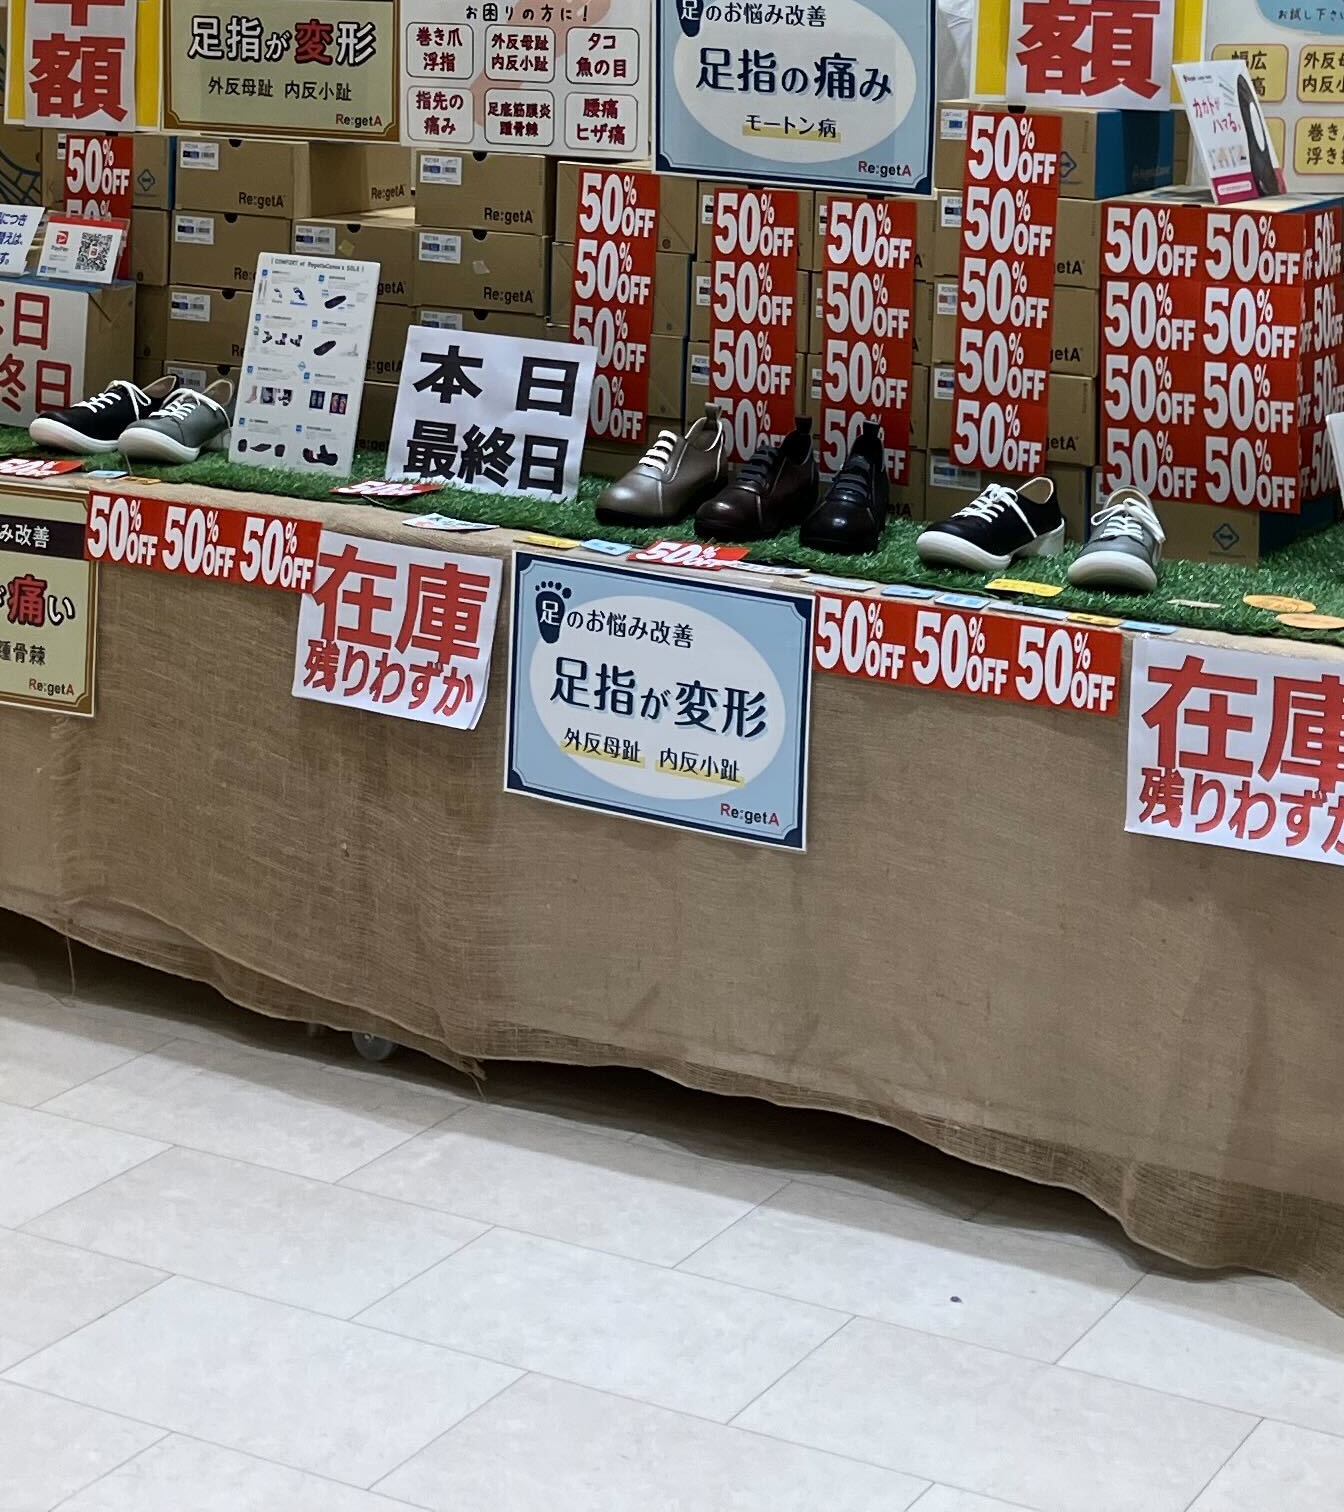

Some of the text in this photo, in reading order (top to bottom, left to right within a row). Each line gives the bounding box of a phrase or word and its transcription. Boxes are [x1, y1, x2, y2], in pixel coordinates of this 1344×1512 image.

[187, 15, 376, 67] 足指が変形
[416, 27, 463, 48] 巻き爪
[492, 33, 549, 51] 外反母趾
[588, 33, 617, 51] タコ
[423, 52, 456, 72] 浮指
[492, 54, 549, 72] 内反小趾
[576, 57, 627, 78] 魚の目
[696, 47, 891, 102] 足指の痛み
[208, 76, 351, 101] 外反母趾 内反小趾
[416, 91, 464, 111] 指先の
[488, 101, 551, 119] 足底筋膜炎
[583, 98, 619, 119] 腰痛
[336, 113, 383, 129] Re:getA
[424, 115, 456, 136] 痛み
[746, 114, 836, 138] モートン病
[577, 122, 625, 145] ヒザ痛
[858, 161, 911, 177] Re:getA
[101, 168, 130, 195] OFF
[238, 191, 285, 208] Re:getA
[483, 206, 534, 224] Re:getA
[875, 238, 912, 268] OFF
[1259, 251, 1300, 284] OFF
[483, 286, 534, 305] Re:getA
[413, 345, 580, 416] 本日
[404, 420, 567, 495] 最終日
[311, 544, 491, 665] 在庫
[538, 598, 694, 650] 足のお悩み改善
[866, 643, 906, 681] OFF
[28, 678, 75, 697] Re:getA
[303, 638, 473, 718] 残りわずか
[550, 655, 767, 738] 足指が変形
[563, 727, 741, 782] 外反母趾 内反小趾
[720, 802, 779, 828] Re:getA
